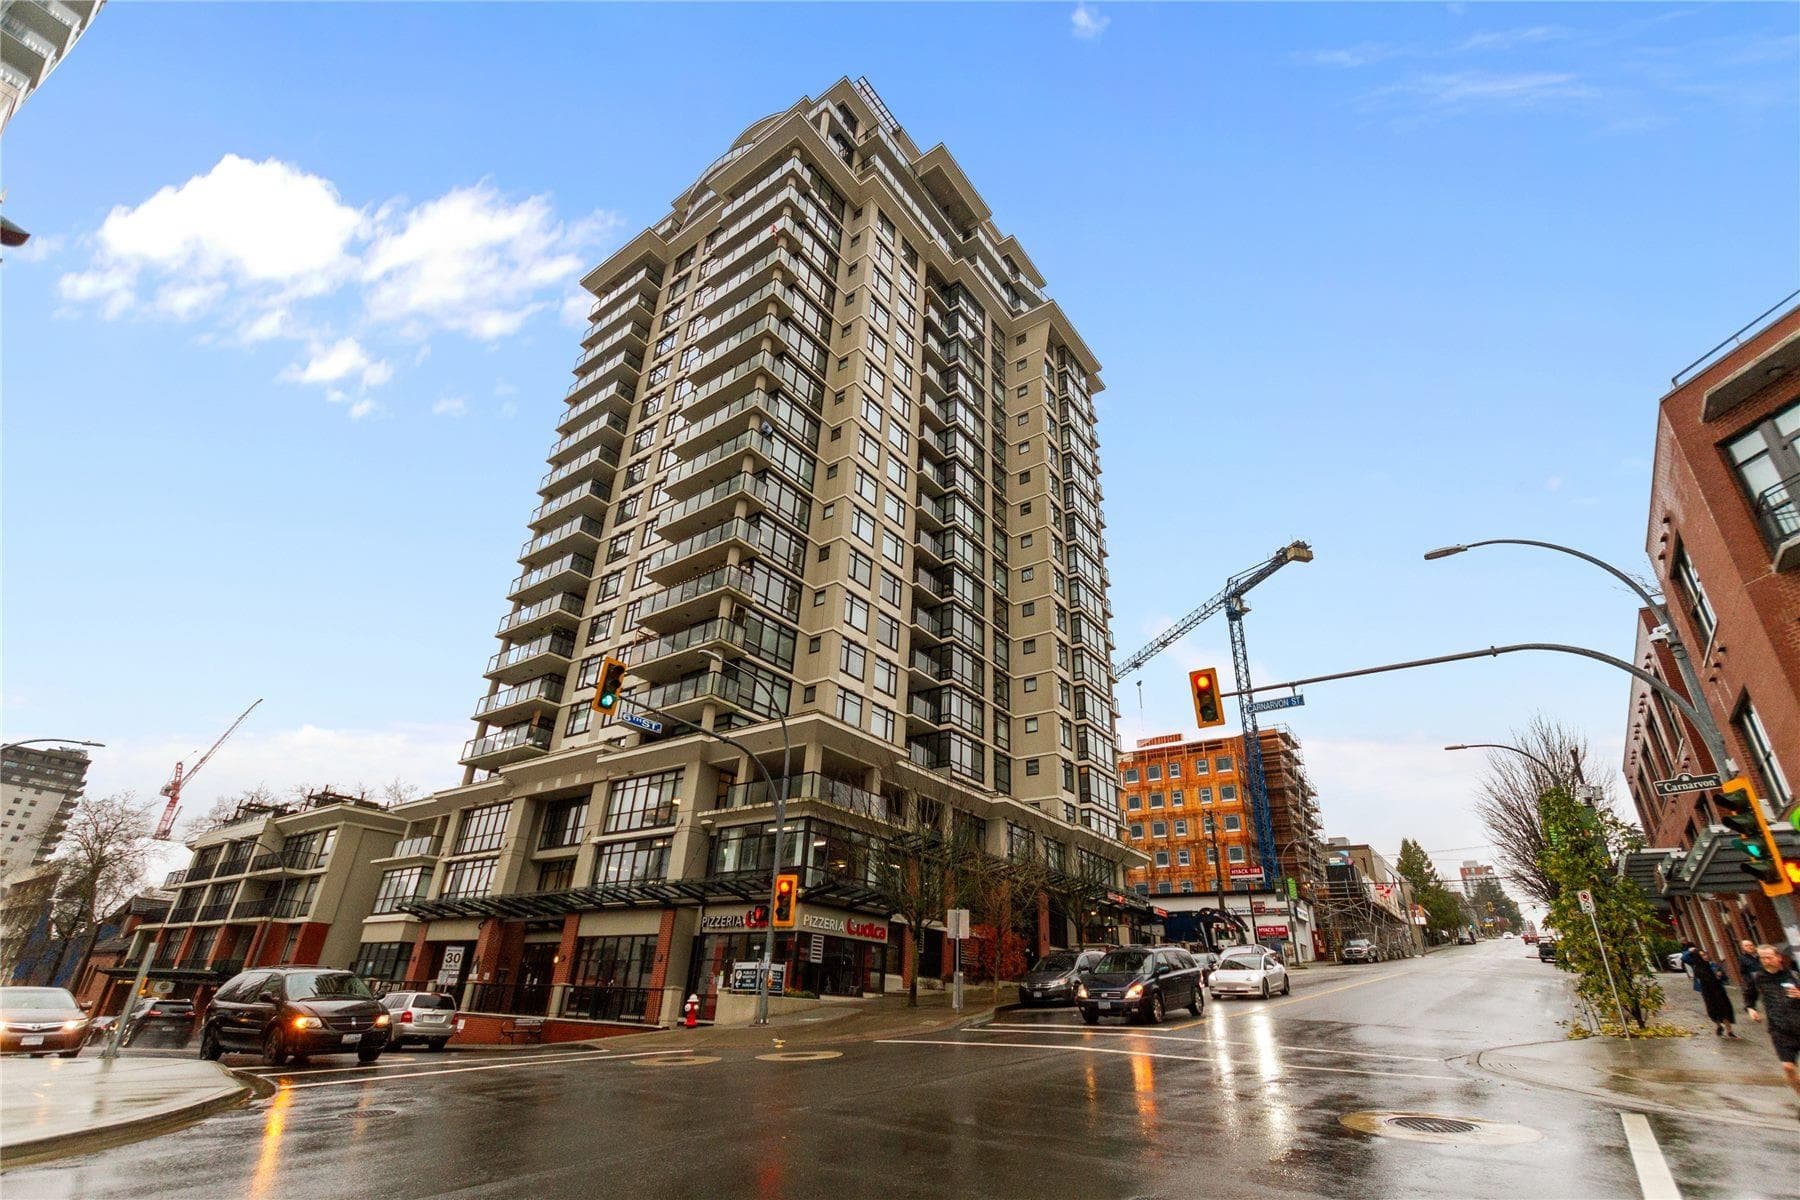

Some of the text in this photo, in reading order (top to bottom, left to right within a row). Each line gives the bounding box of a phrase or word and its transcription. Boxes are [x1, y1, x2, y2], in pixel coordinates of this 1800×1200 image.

[1247, 699, 1290, 712] CARNARVON
[1664, 780, 1716, 792] Carnarvon
[702, 915, 744, 928] PIZZERIA
[803, 914, 845, 932] PIZZERIA
[445, 952, 461, 964] 30
